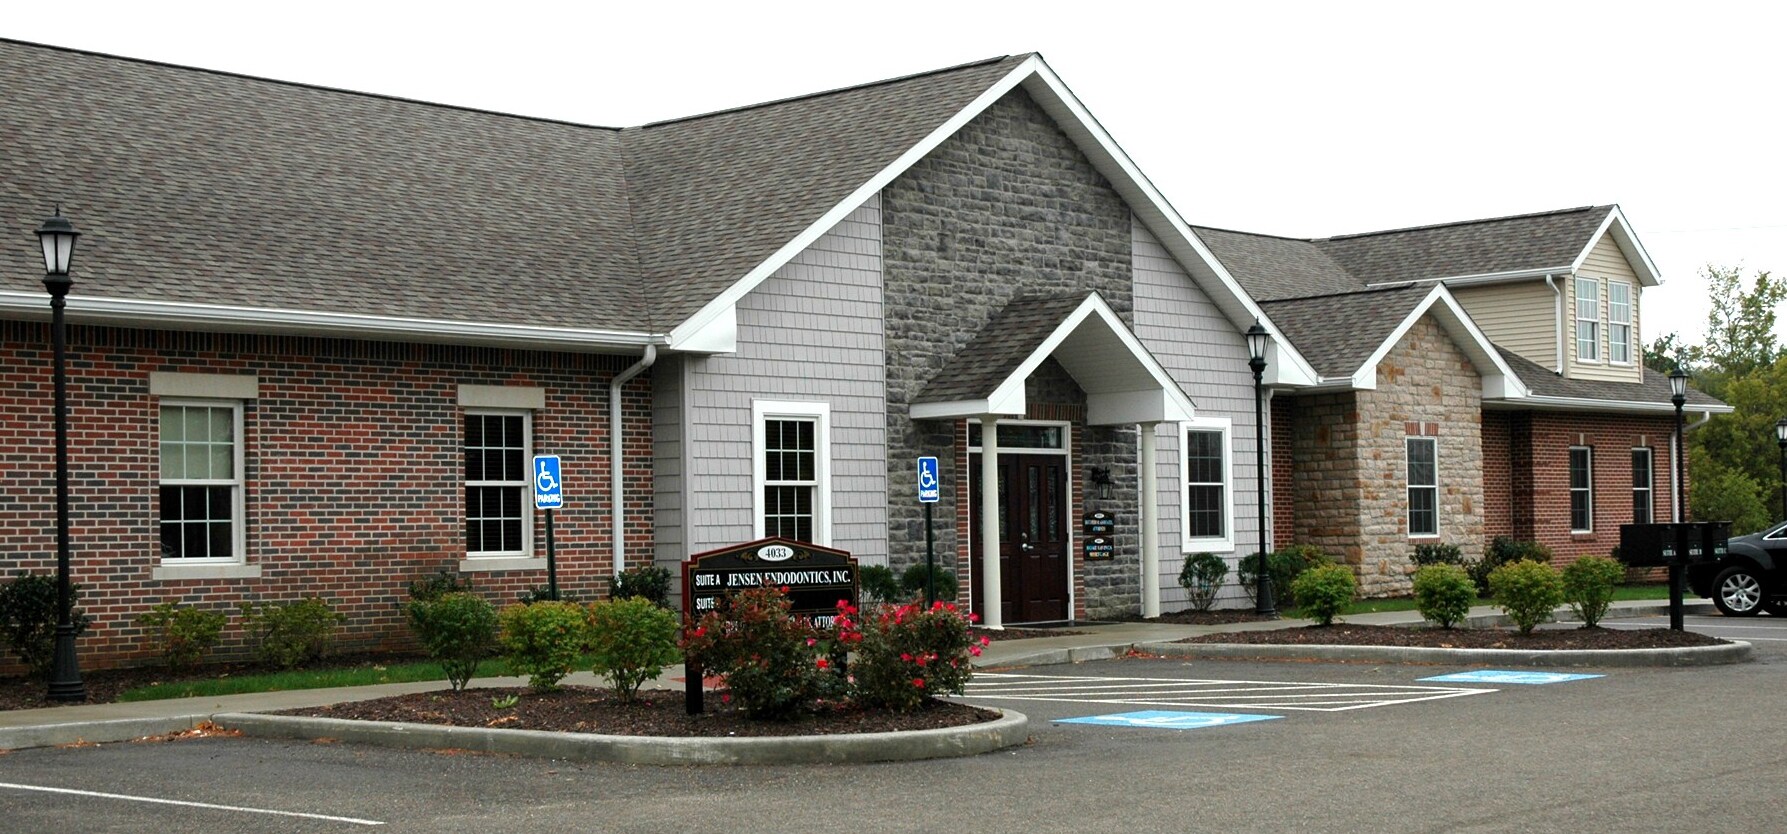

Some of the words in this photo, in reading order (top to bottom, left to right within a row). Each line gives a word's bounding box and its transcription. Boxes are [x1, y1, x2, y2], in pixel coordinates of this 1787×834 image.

[765, 547, 787, 558] 4033
[695, 574, 715, 587] SUITE
[715, 574, 721, 586] A
[726, 572, 763, 587] JENSEN
[764, 570, 832, 585] ENDODONTICS,
[833, 570, 851, 583] INC.
